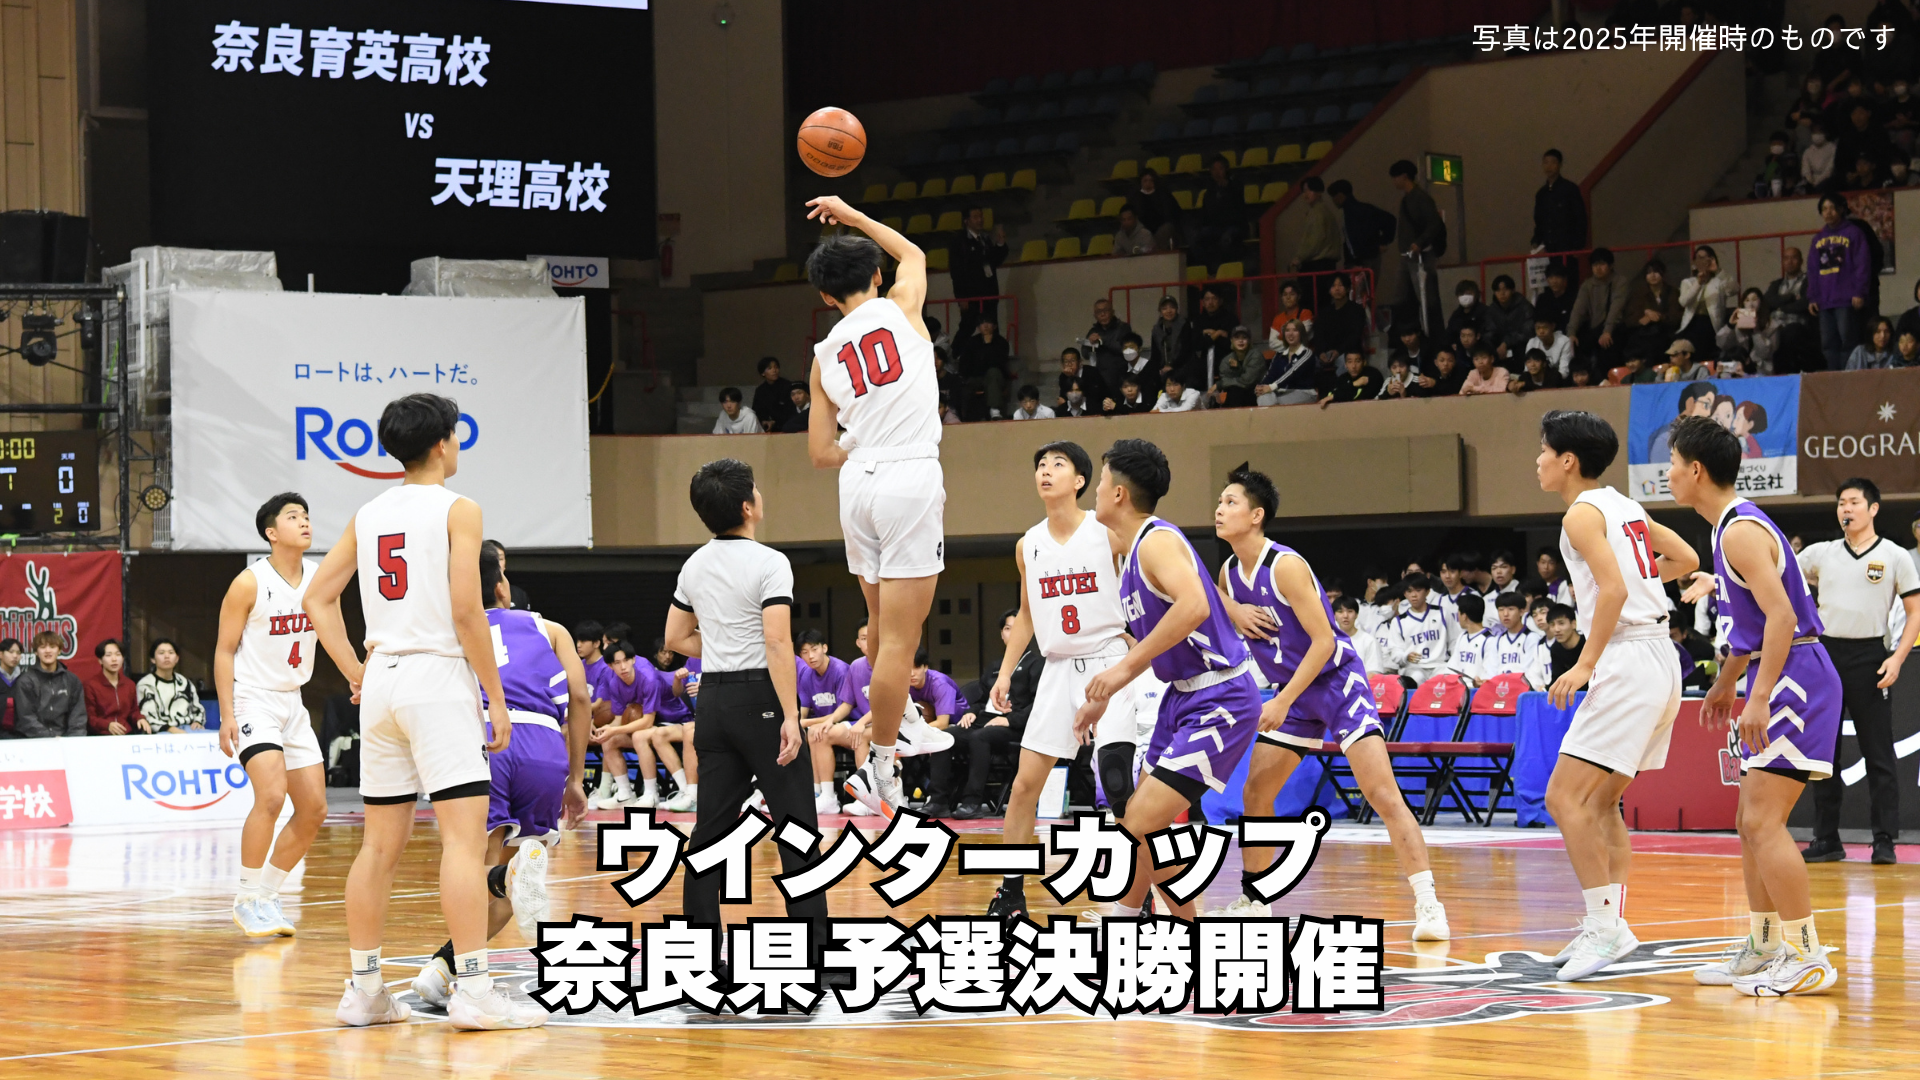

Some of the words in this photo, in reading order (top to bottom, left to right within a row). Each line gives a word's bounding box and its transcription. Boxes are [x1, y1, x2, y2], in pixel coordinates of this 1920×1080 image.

[211, 20, 491, 88] 奈良育英高校
[430, 157, 610, 213] 天理高校
[547, 263, 598, 279] OHTO
[295, 361, 478, 386] ロートは、ハートだ。
[837, 327, 904, 398] 10
[295, 406, 479, 461] ROO
[1803, 430, 1920, 459] GEOGRA
[58, 466, 74, 494] 0
[1622, 519, 1659, 579] 17
[378, 532, 408, 600] 5
[1039, 572, 1099, 599] IKUEI
[269, 613, 316, 635] IKUE
[1061, 604, 1081, 635] 8
[1269, 636, 1283, 664] 7
[1410, 629, 1440, 646] TENRI
[20, 653, 36, 665] ara
[288, 641, 302, 669] 4
[132, 741, 222, 754] ロートは、ハート
[121, 763, 250, 801] ROHTO
